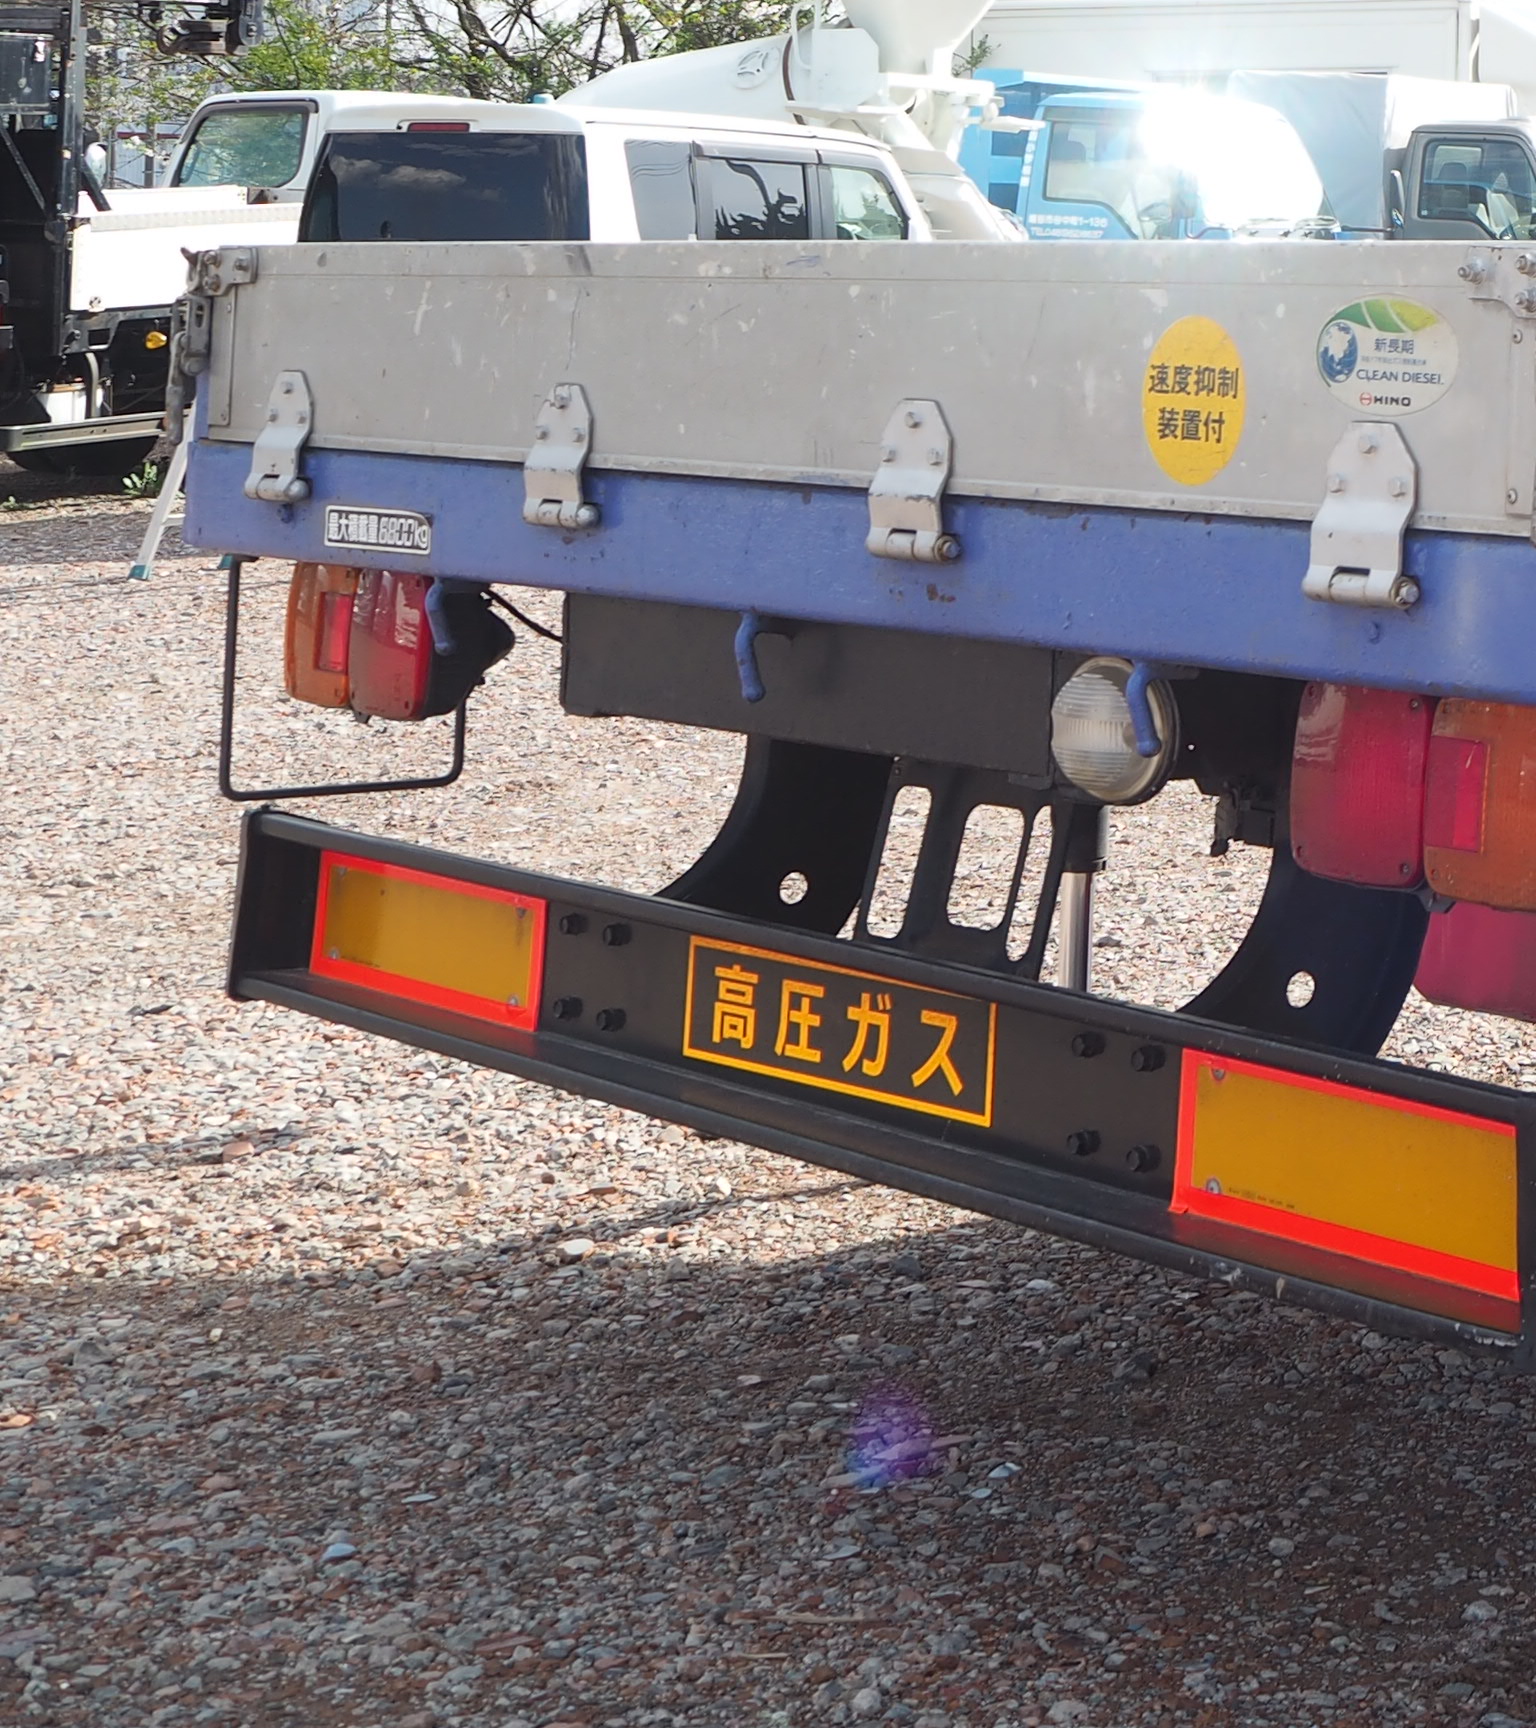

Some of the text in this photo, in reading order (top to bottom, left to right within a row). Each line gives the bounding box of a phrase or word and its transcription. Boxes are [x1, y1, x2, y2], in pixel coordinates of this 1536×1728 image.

[1148, 364, 1240, 400] 速度抑制
[1356, 369, 1399, 383] CLEAN
[1373, 395, 1411, 408] HINO
[1157, 407, 1226, 445] 装置付
[712, 963, 963, 1097] 高圧ガス
